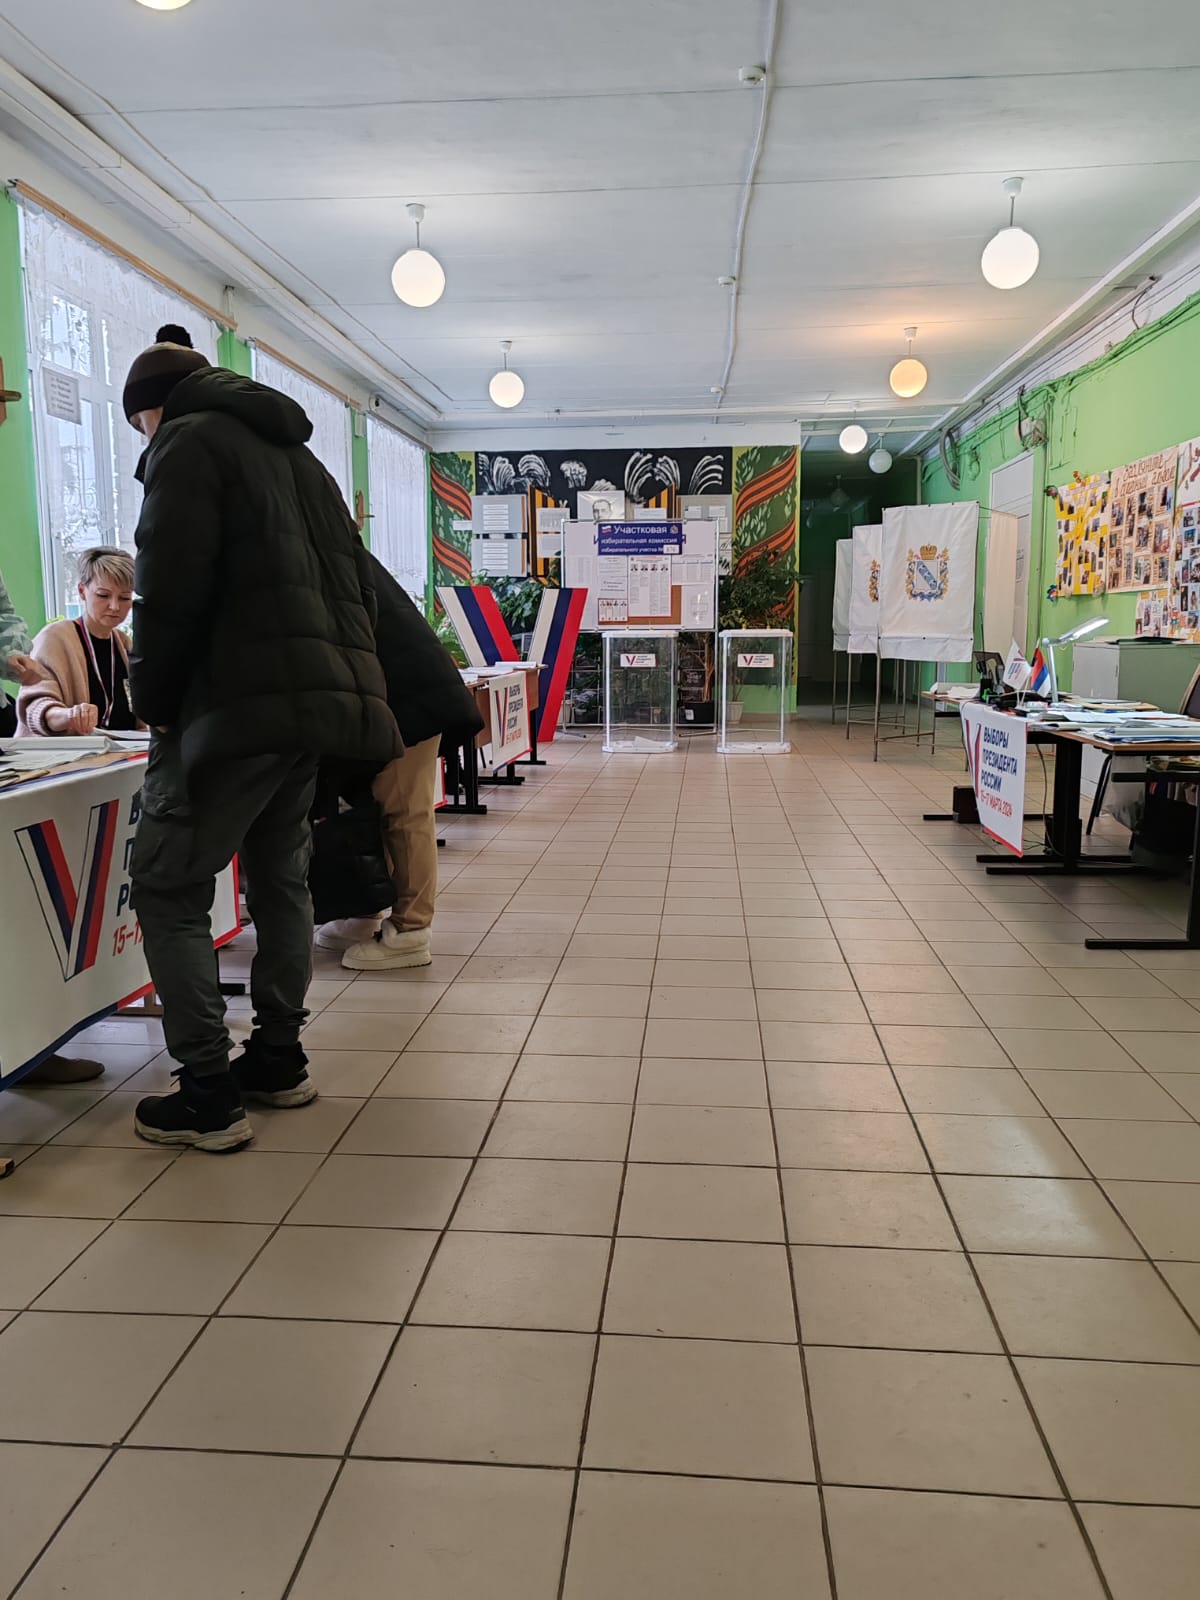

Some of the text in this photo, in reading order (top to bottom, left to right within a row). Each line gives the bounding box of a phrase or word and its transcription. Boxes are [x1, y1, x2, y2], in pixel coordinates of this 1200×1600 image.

[613, 525, 668, 535] Участковая
[600, 538, 647, 546] избирательная
[983, 726, 1010, 749] ВЫБОРЫ
[982, 748, 1018, 777] ПРЕЗИДЕНТА
[981, 769, 1003, 793] РОССИИ
